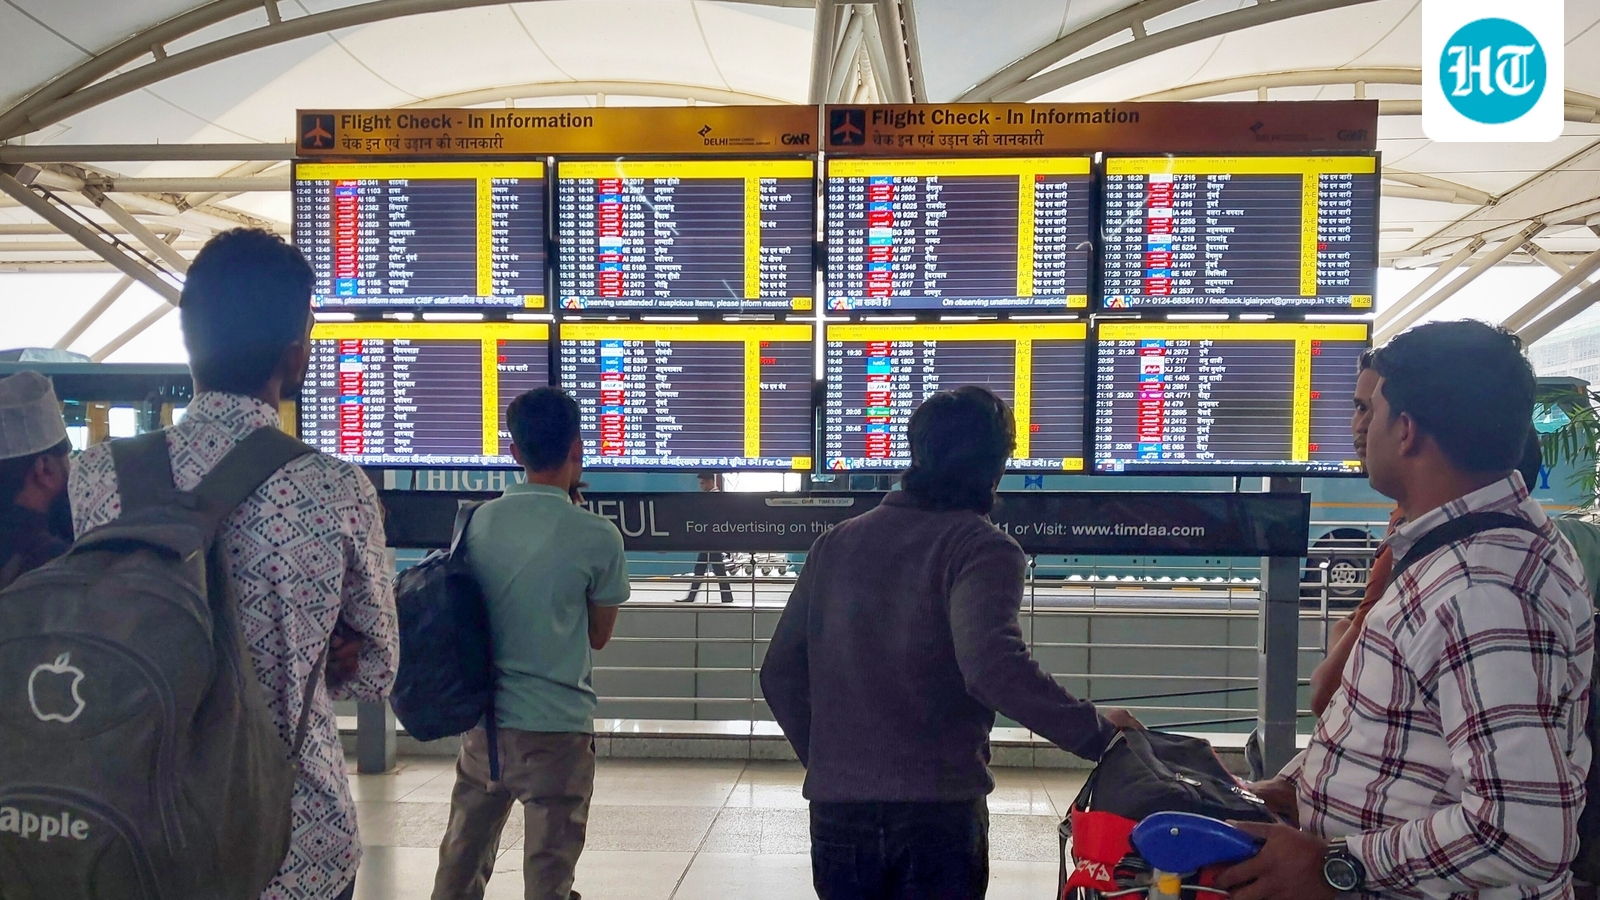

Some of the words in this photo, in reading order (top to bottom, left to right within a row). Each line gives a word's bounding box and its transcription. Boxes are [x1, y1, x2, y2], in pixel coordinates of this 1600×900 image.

[340, 114, 391, 132] Flight
[397, 113, 452, 128] Check
[468, 114, 484, 128] In
[490, 113, 593, 128] Information
[872, 109, 926, 128] Flight
[930, 108, 990, 124] Check
[1006, 108, 1024, 124] In
[1030, 108, 1140, 124] Information
[342, 134, 362, 149] चेक
[365, 138, 380, 152] इन
[384, 134, 400, 150] एवं
[404, 137, 432, 152] उड़ान
[436, 134, 450, 149] की
[454, 134, 504, 149] जानकारी
[874, 131, 894, 146] चेक
[897, 134, 913, 148] इन
[918, 130, 934, 147] एवं
[938, 134, 969, 148] उड़ान
[972, 129, 989, 146] की
[992, 129, 1045, 146] जानकारी
[659, 299, 694, 308] suspicious
[717, 300, 739, 308] please
[955, 298, 989, 307] observing
[1034, 298, 1067, 306] suspiciou
[686, 521, 708, 533] For
[712, 521, 785, 536] advertising
[790, 524, 806, 533] on
[811, 521, 834, 533] this
[1015, 525, 1029, 535] or
[1034, 522, 1067, 535] Visit:
[1072, 522, 1205, 537] www.timdaa.com
[0, 806, 89, 842] apple
